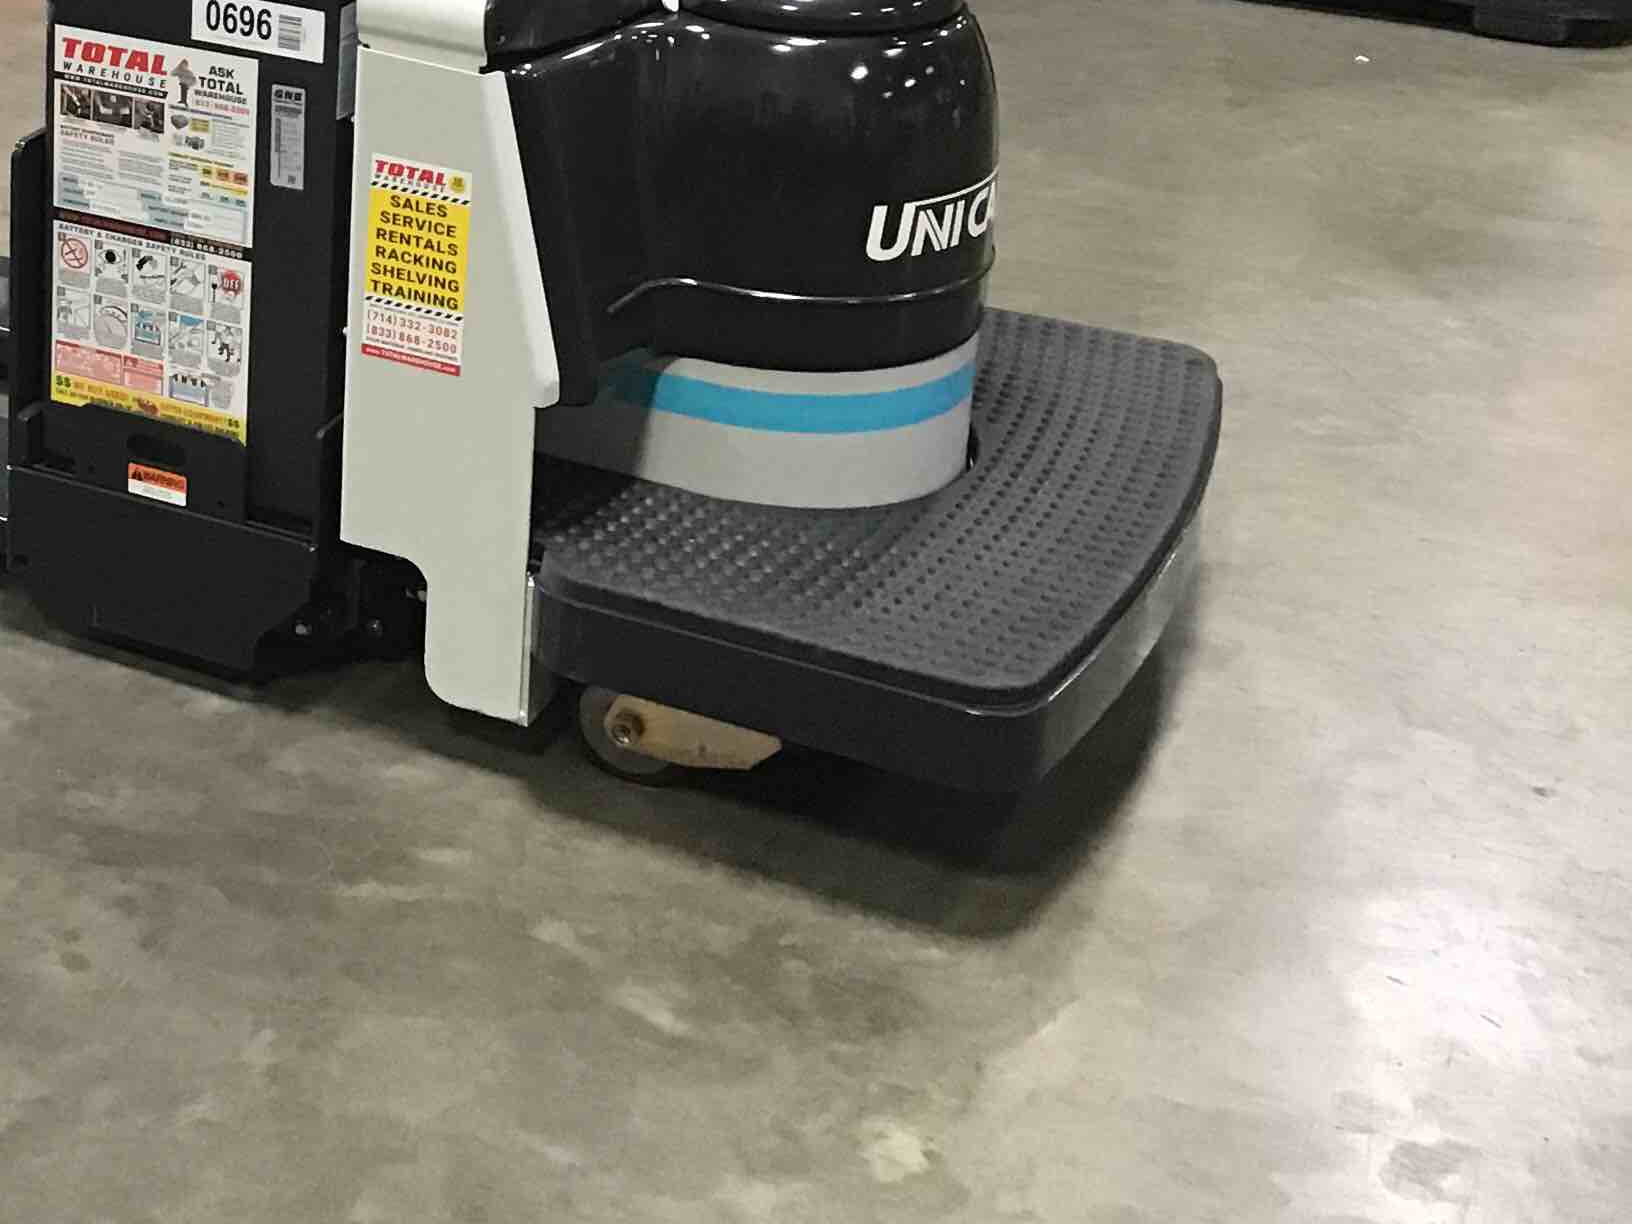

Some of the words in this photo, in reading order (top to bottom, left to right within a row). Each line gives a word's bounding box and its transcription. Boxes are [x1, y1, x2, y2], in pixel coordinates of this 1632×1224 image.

[206, 0, 272, 40] 0696
[63, 37, 168, 75] TOTAL
[63, 61, 167, 89] WAREHOUSE
[198, 76, 244, 95] TOTAL
[208, 66, 235, 79] ASK
[376, 160, 446, 186] TOTAL
[390, 195, 448, 218] SALES
[380, 210, 457, 239] SERVICE
[376, 228, 458, 256] RENTALS
[375, 245, 457, 274] RACKING
[371, 262, 460, 293] SHELVING
[370, 279, 459, 310] TRAINING
